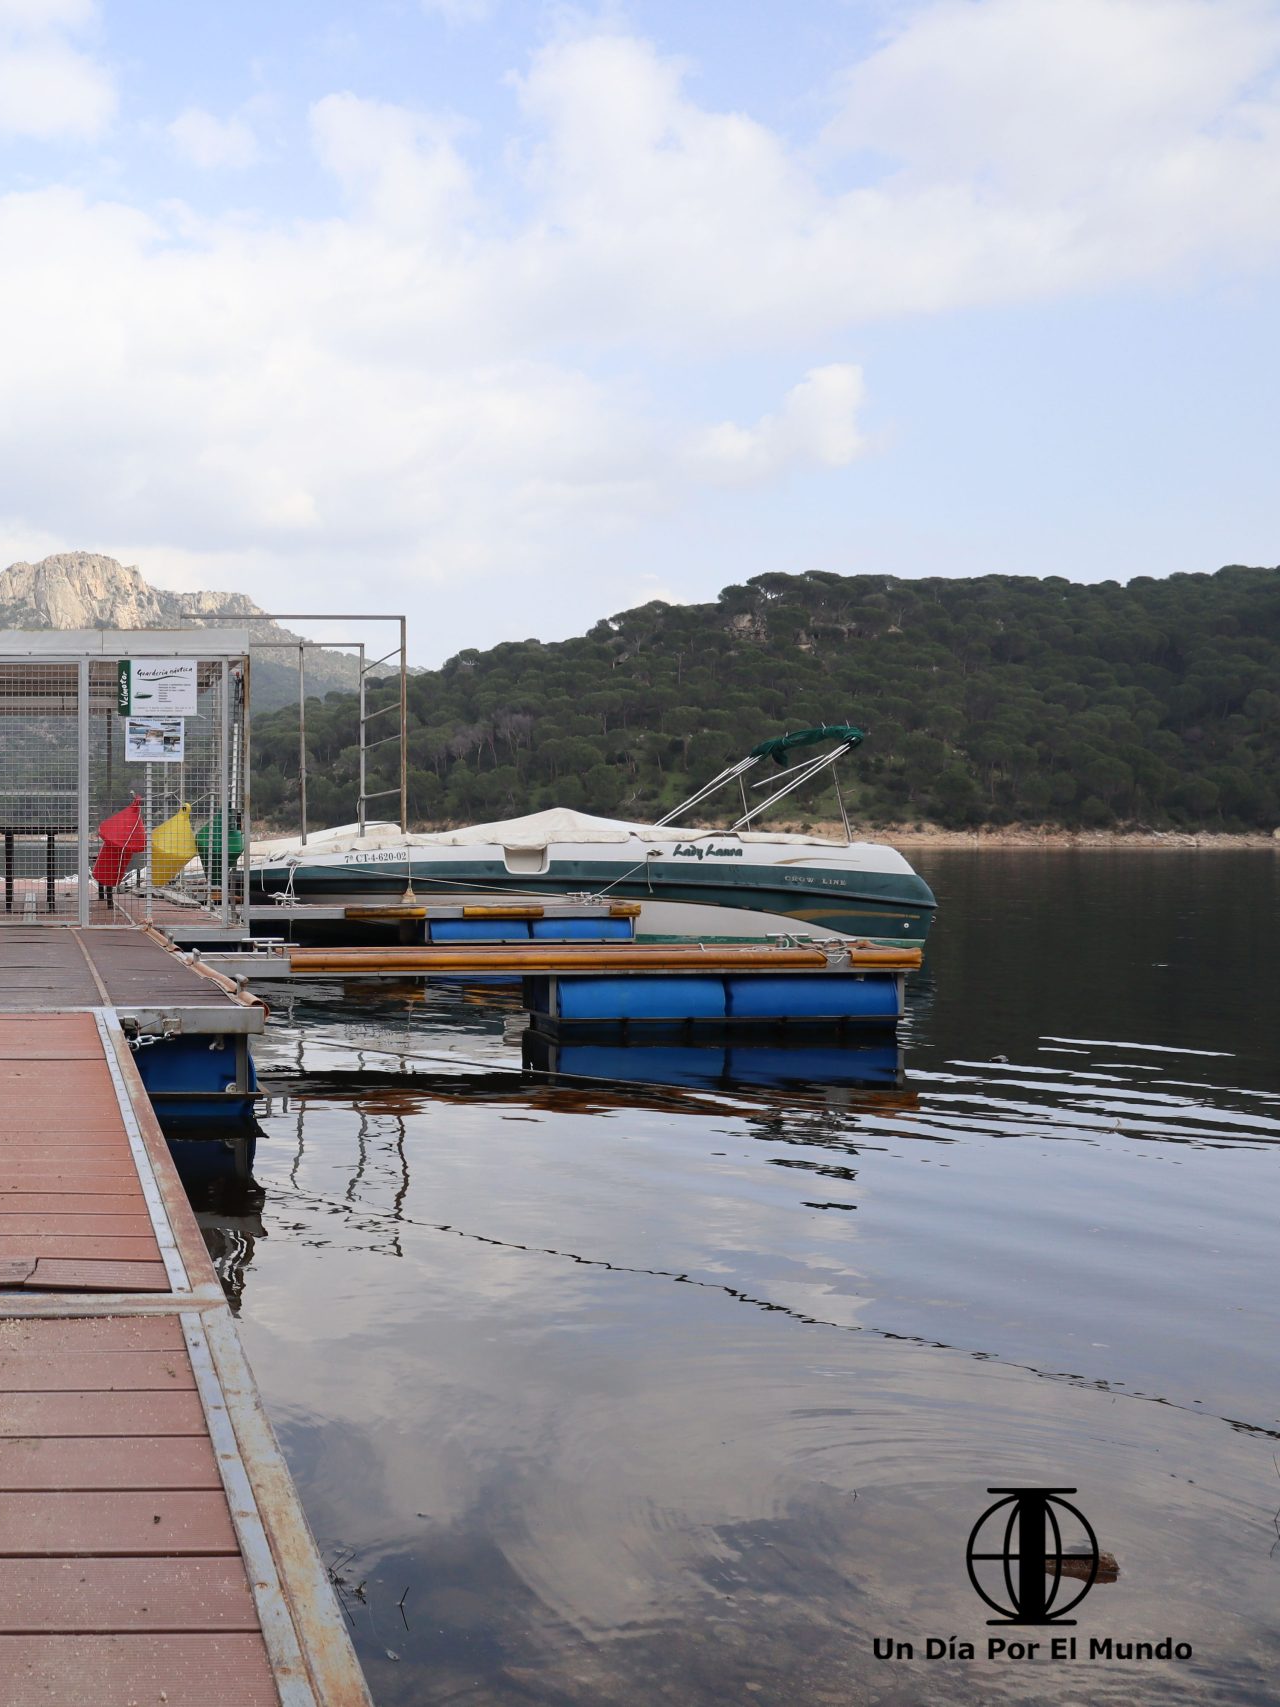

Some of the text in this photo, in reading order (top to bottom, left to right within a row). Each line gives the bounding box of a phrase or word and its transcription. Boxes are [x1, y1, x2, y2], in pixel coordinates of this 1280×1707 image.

[120, 671, 129, 707] Velmotor
[356, 852, 407, 863] CT-4-620-02
[673, 843, 704, 861] Lady
[784, 875, 847, 886] CROW LINE
